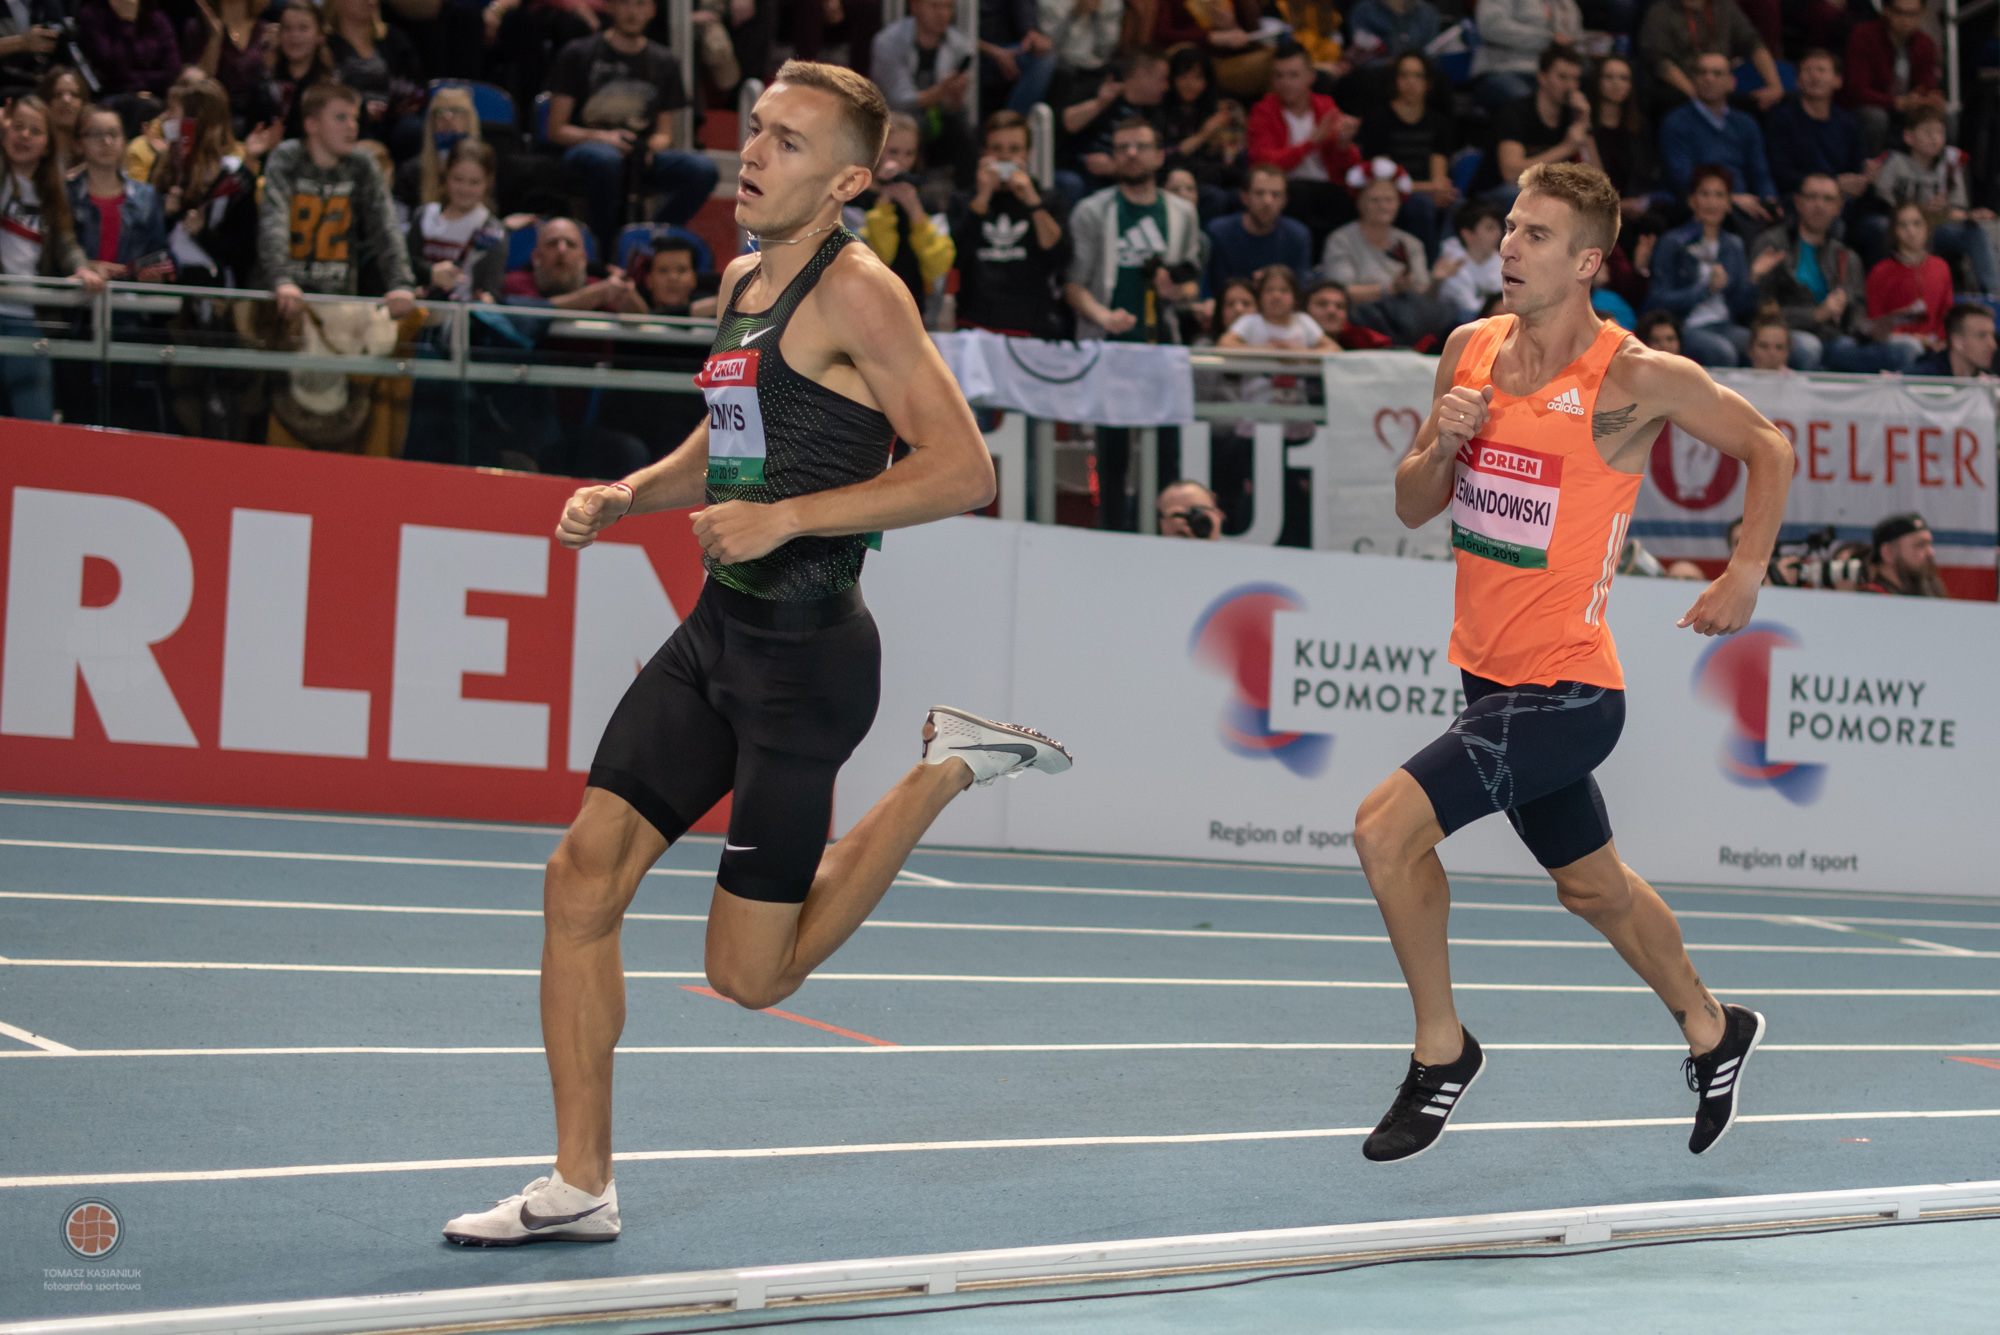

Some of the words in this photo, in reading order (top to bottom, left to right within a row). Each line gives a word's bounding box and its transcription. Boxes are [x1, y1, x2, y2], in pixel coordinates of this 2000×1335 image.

[714, 361, 744, 378] ORLEN
[1547, 401, 1584, 416] adidas
[719, 466, 739, 480] 2019
[1483, 451, 1538, 476] ORLEN
[1455, 474, 1551, 527] LEWANDOWSKI
[1488, 539, 1506, 549] Indoor
[1507, 543, 1522, 552] Tour
[1492, 547, 1520, 563] 2019
[1295, 638, 1437, 676] KUJAWY
[1293, 678, 1467, 716] POMORZE
[1791, 674, 1926, 708] KUJAWY
[1789, 711, 1956, 748] POMORZE
[1209, 820, 1277, 847] Region
[1283, 824, 1303, 844] of
[1719, 846, 1782, 870] Region
[1787, 849, 1806, 868] of
[1811, 854, 1859, 873] sport
